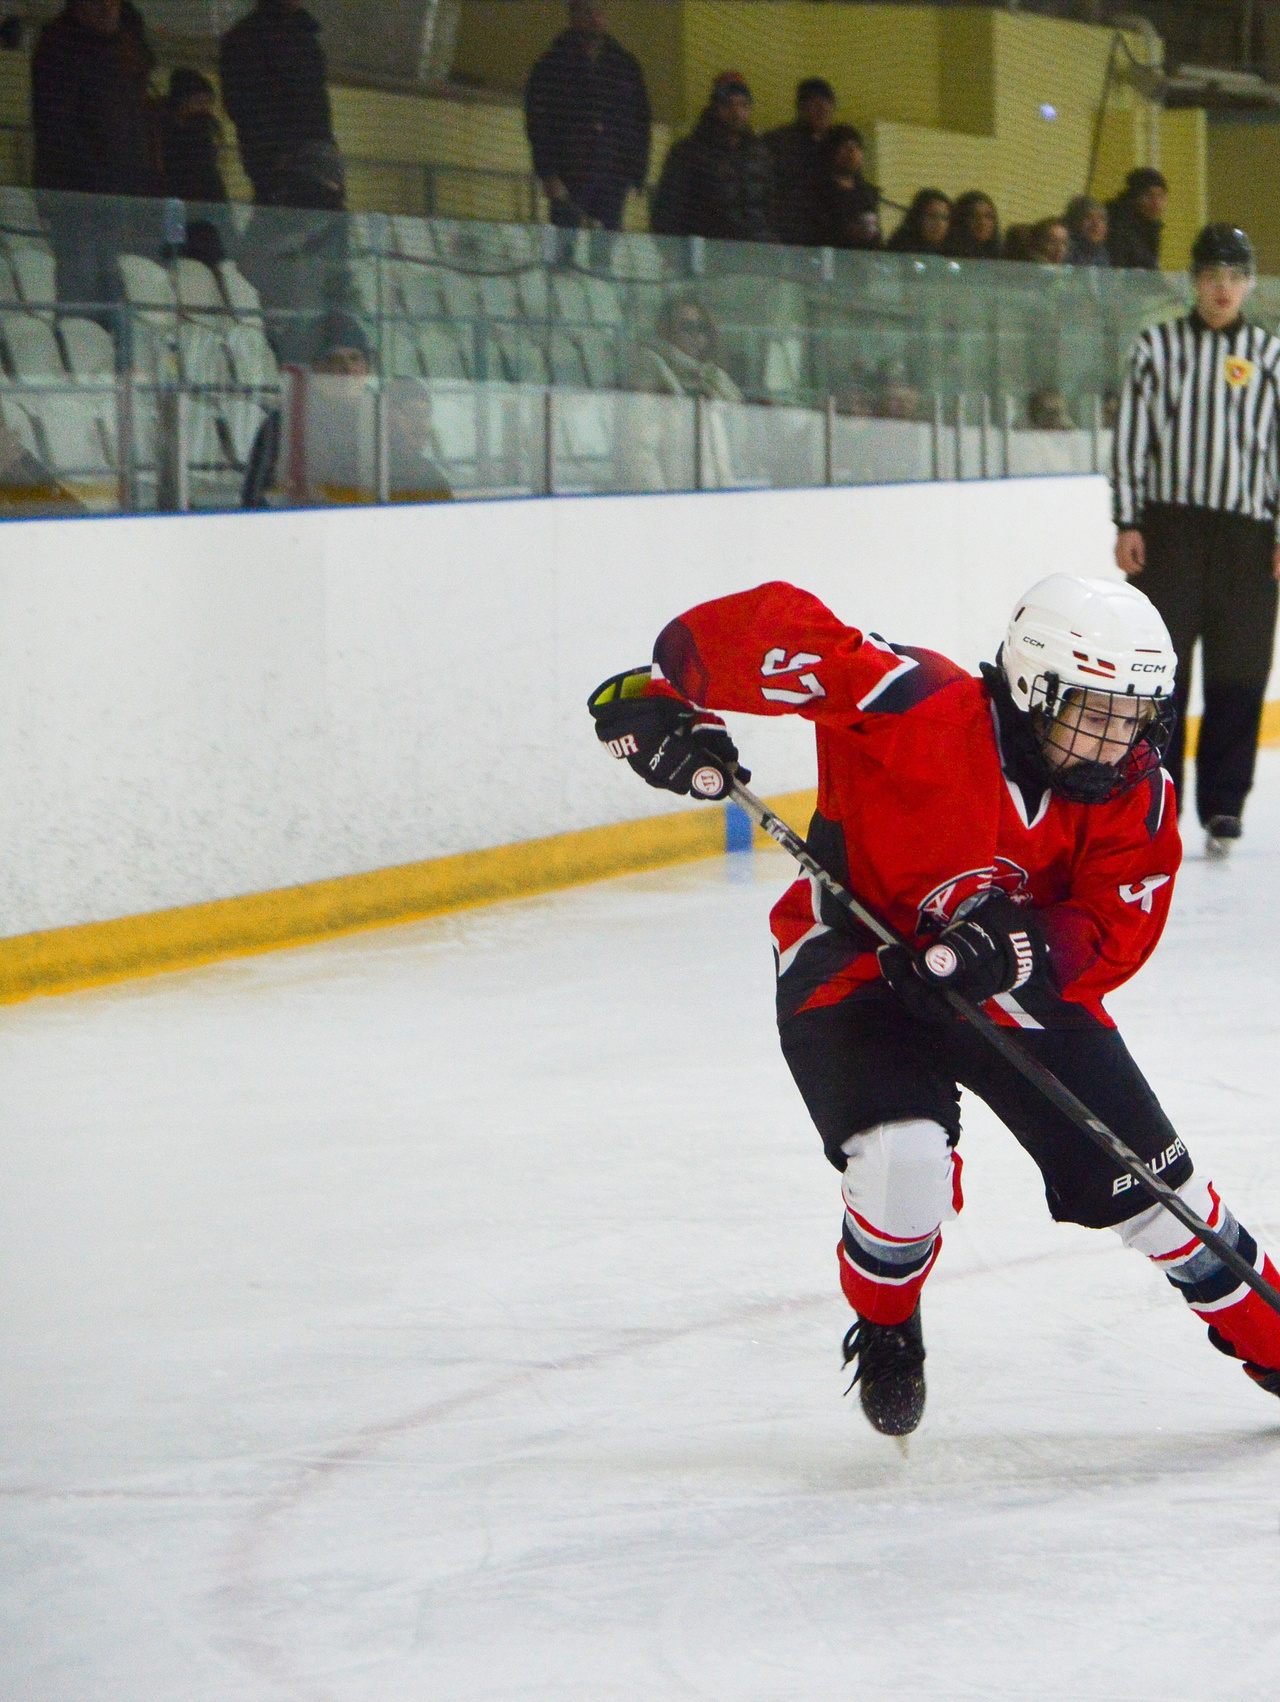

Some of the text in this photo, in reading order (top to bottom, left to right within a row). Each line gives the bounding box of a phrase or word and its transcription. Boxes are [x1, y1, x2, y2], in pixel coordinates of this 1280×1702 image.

[1022, 636, 1045, 649] CCM
[1130, 662, 1167, 674] CCM
[604, 732, 640, 759] OR
